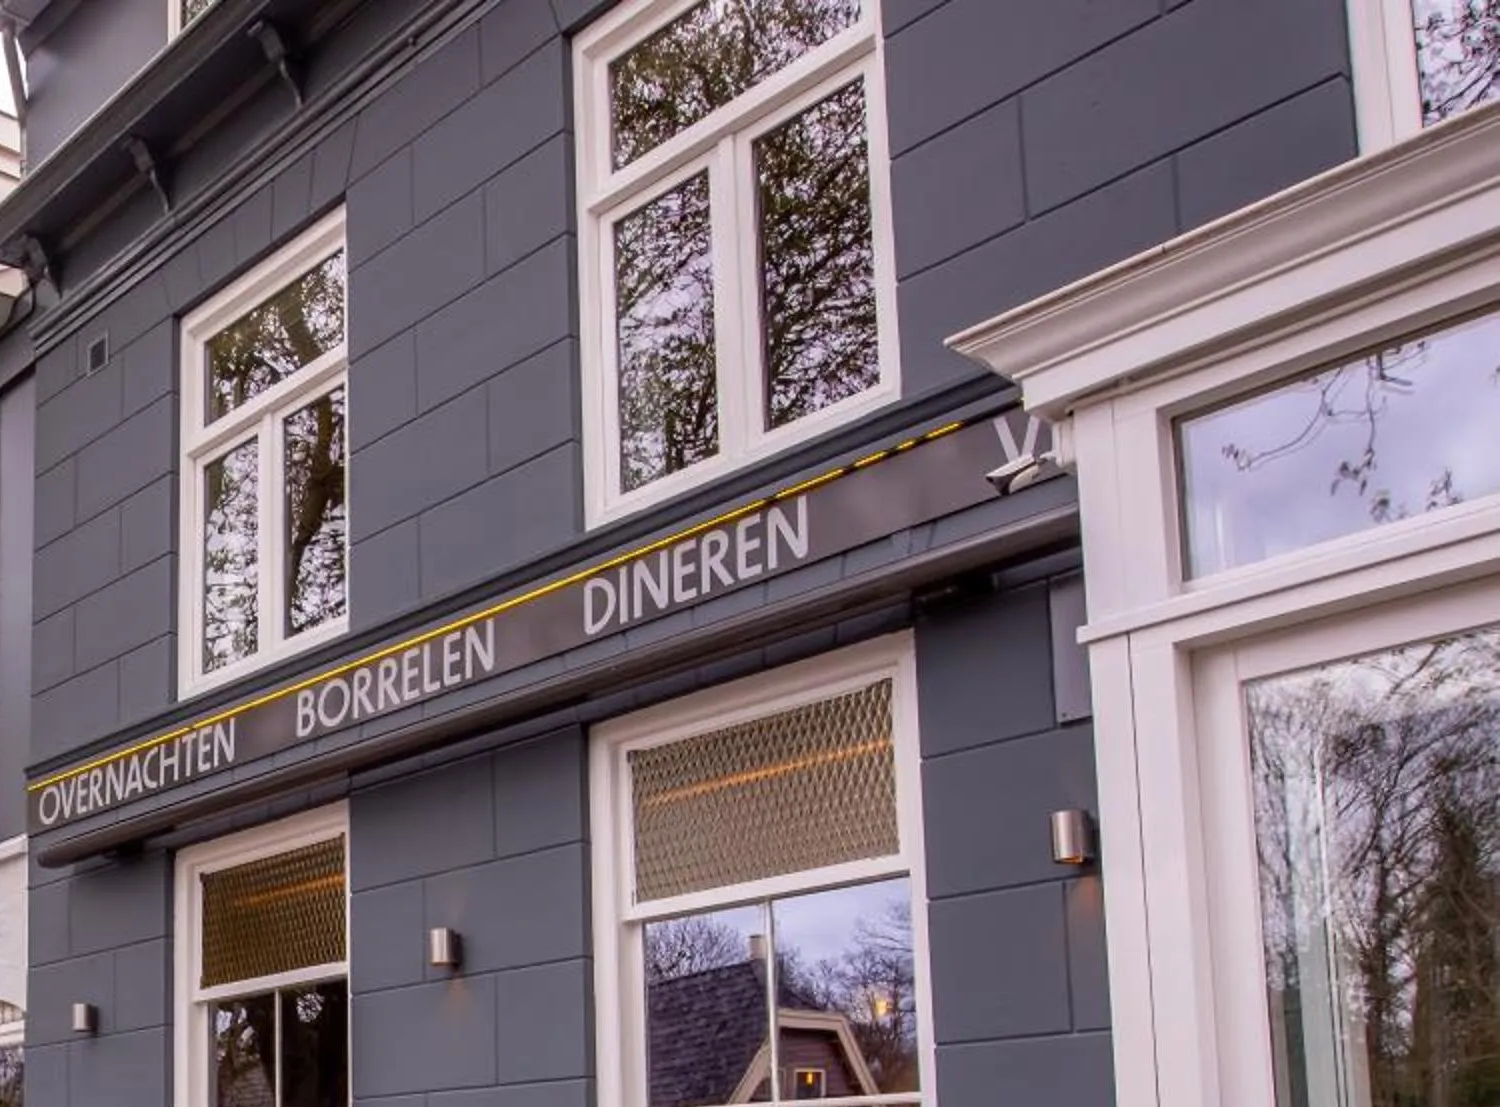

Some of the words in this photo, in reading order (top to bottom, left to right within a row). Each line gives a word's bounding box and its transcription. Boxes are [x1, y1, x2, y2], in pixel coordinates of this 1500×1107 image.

[39, 717, 235, 825] OVERNACHTEN
[296, 618, 495, 737] BORRELEN
[583, 496, 808, 635] DINEREN
